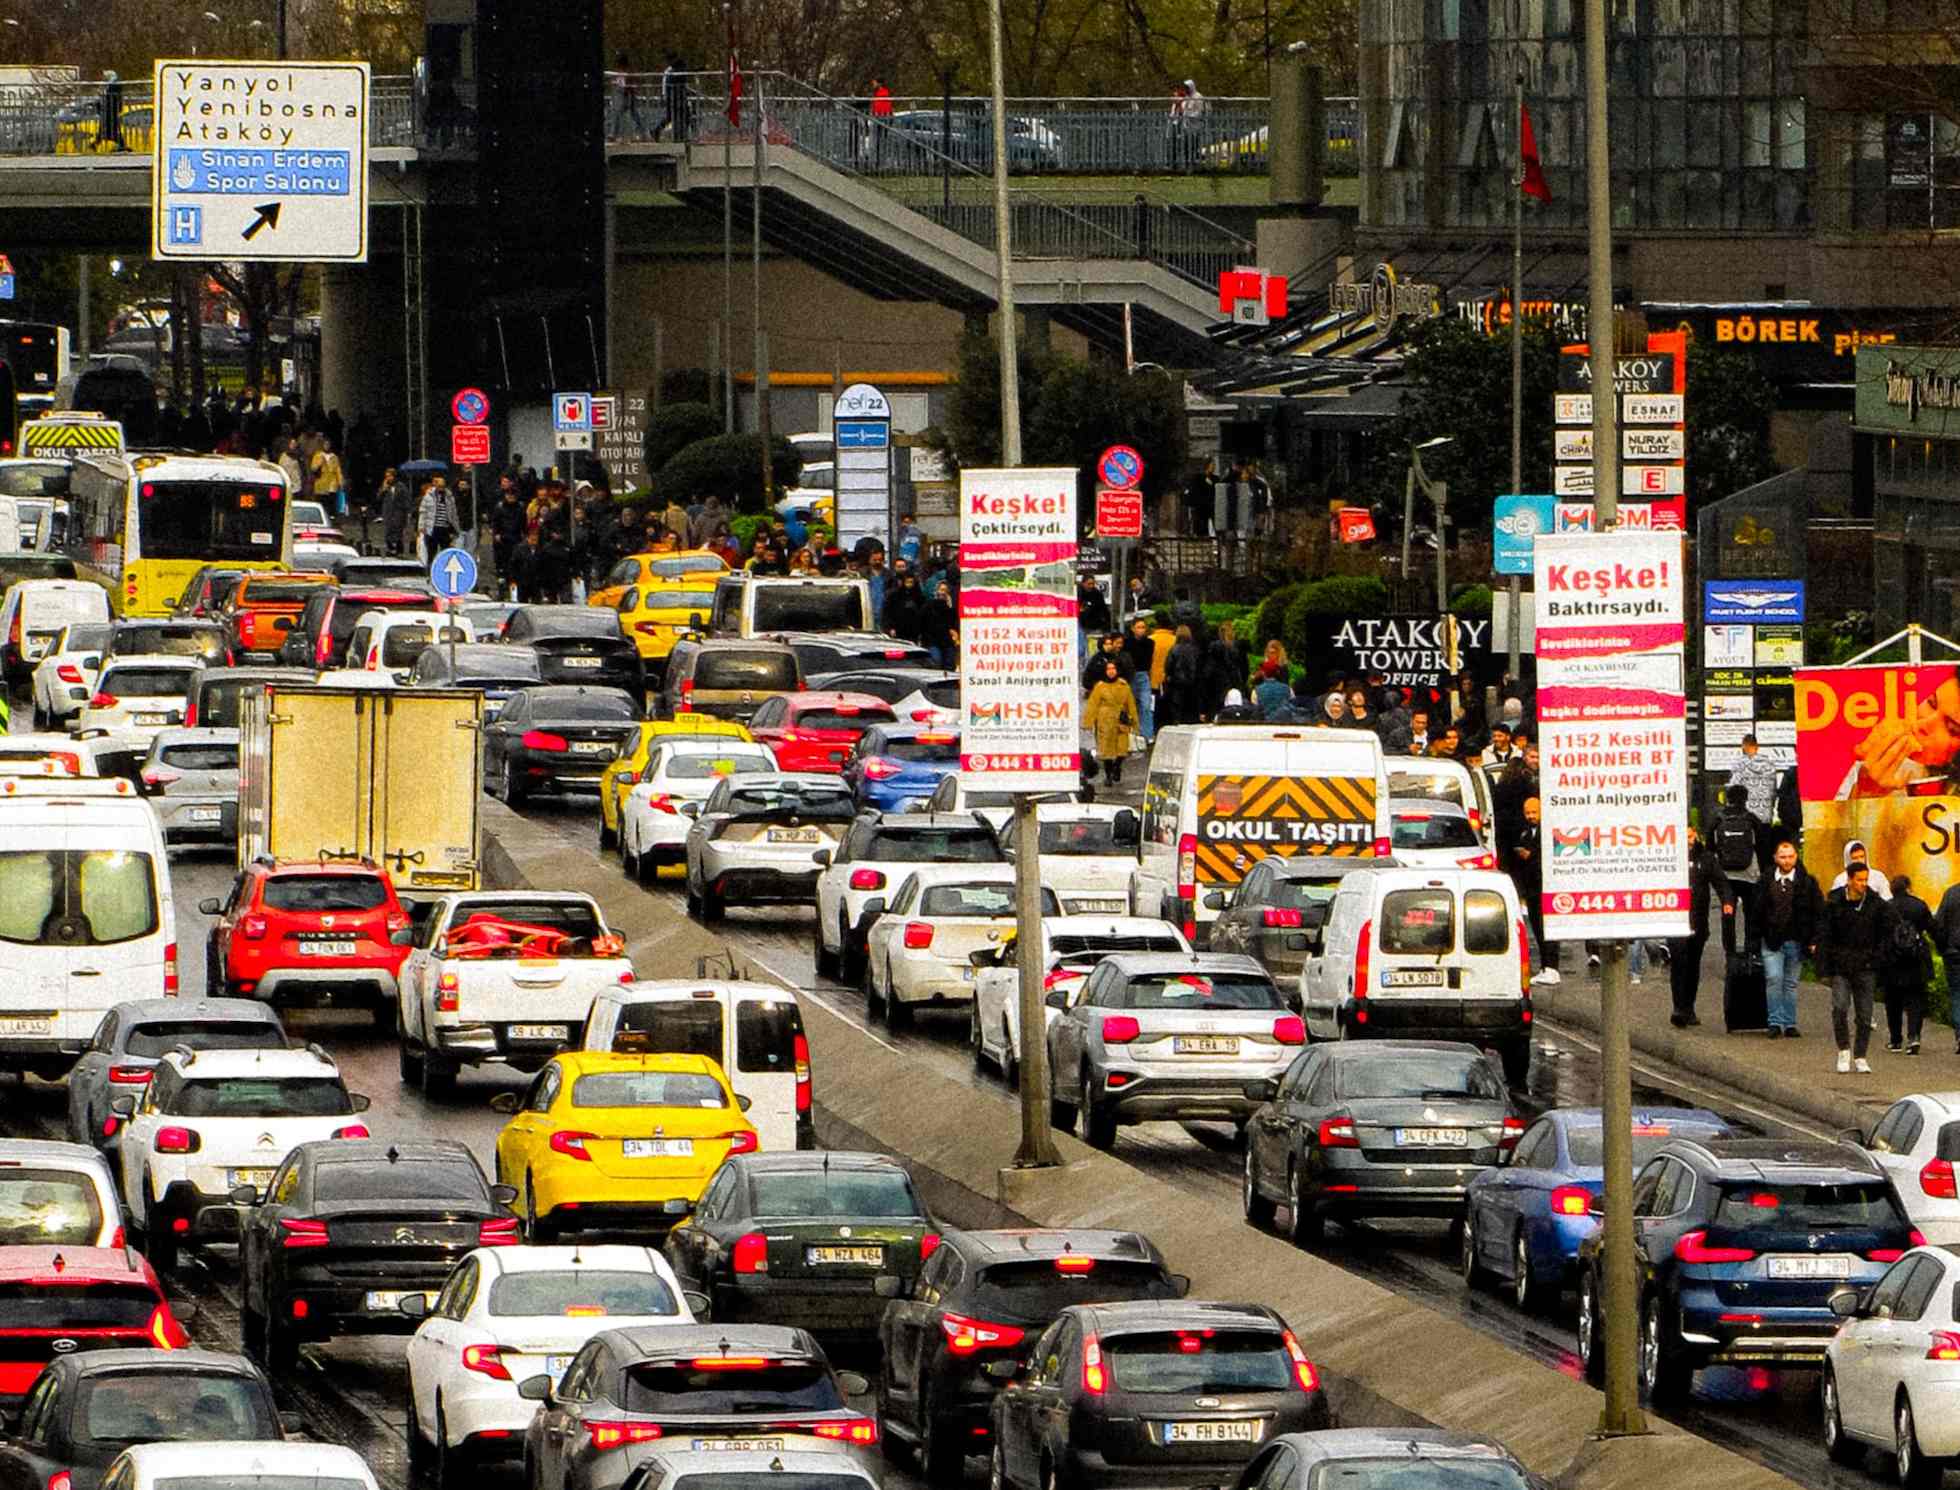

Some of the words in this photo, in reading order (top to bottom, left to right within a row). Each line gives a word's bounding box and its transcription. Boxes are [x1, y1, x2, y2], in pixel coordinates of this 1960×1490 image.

[177, 72, 293, 96] Yanyol
[177, 97, 358, 118] Yenibosna
[176, 121, 294, 145] Ataköy
[202, 150, 265, 168] Sinan
[274, 151, 345, 169] Erdem
[207, 173, 259, 191] Spor
[264, 173, 341, 191] Salonu
[175, 208, 197, 240] H
[1715, 316, 1820, 342] BÖREK
[868, 398, 883, 410] 22
[1632, 405, 1676, 415] ESNAF
[1628, 435, 1671, 445] NURAY
[33, 447, 66, 458] OKUL
[1560, 446, 1592, 455] CHIPA
[1628, 445, 1670, 454] YILDIZ
[1646, 471, 1661, 489] E
[971, 492, 1067, 521] Keşke!
[972, 521, 1065, 537] Çektirseydi.
[1548, 561, 1669, 598] Keşke!
[1549, 600, 1670, 617] Baktırsaydı.
[972, 628, 1010, 640] 1152
[1017, 627, 1067, 640] Kesitli
[970, 642, 1044, 655] KORONER
[1051, 642, 1069, 655] BT
[976, 658, 1063, 673] Anjiyografi
[1354, 649, 1465, 670] TOWERS
[969, 676, 1000, 686] Sanal
[1006, 676, 1071, 688] Anjiyografi
[1004, 702, 1070, 720] HSM
[1551, 732, 1600, 749] 1152
[1609, 730, 1672, 748] Kesitli
[991, 757, 1020, 769] 444
[1026, 757, 1034, 769] 1
[1041, 757, 1071, 769] 800
[1551, 750, 1642, 768] KORONER
[1651, 750, 1674, 764] BT
[1558, 770, 1668, 790] Anjiyografi
[1551, 794, 1591, 807] Sanal
[1596, 791, 1677, 806] Anjiyografi
[1206, 820, 1281, 840] OKUL
[1287, 821, 1372, 845] TAŞITI
[1594, 824, 1677, 848] HSM
[1578, 894, 1616, 910] 444
[1623, 894, 1632, 909] 1
[1641, 892, 1678, 908] 800
[1181, 1040, 1193, 1050] 34
[1403, 1130, 1415, 1140] 34
[1443, 1130, 1465, 1140] 422
[630, 1141, 643, 1153] 34
[815, 1248, 829, 1260] 34
[1776, 1260, 1790, 1273] 34
[1172, 1425, 1188, 1439] 34
[1196, 1425, 1212, 1439] FH
[1217, 1425, 1249, 1439] 8144
